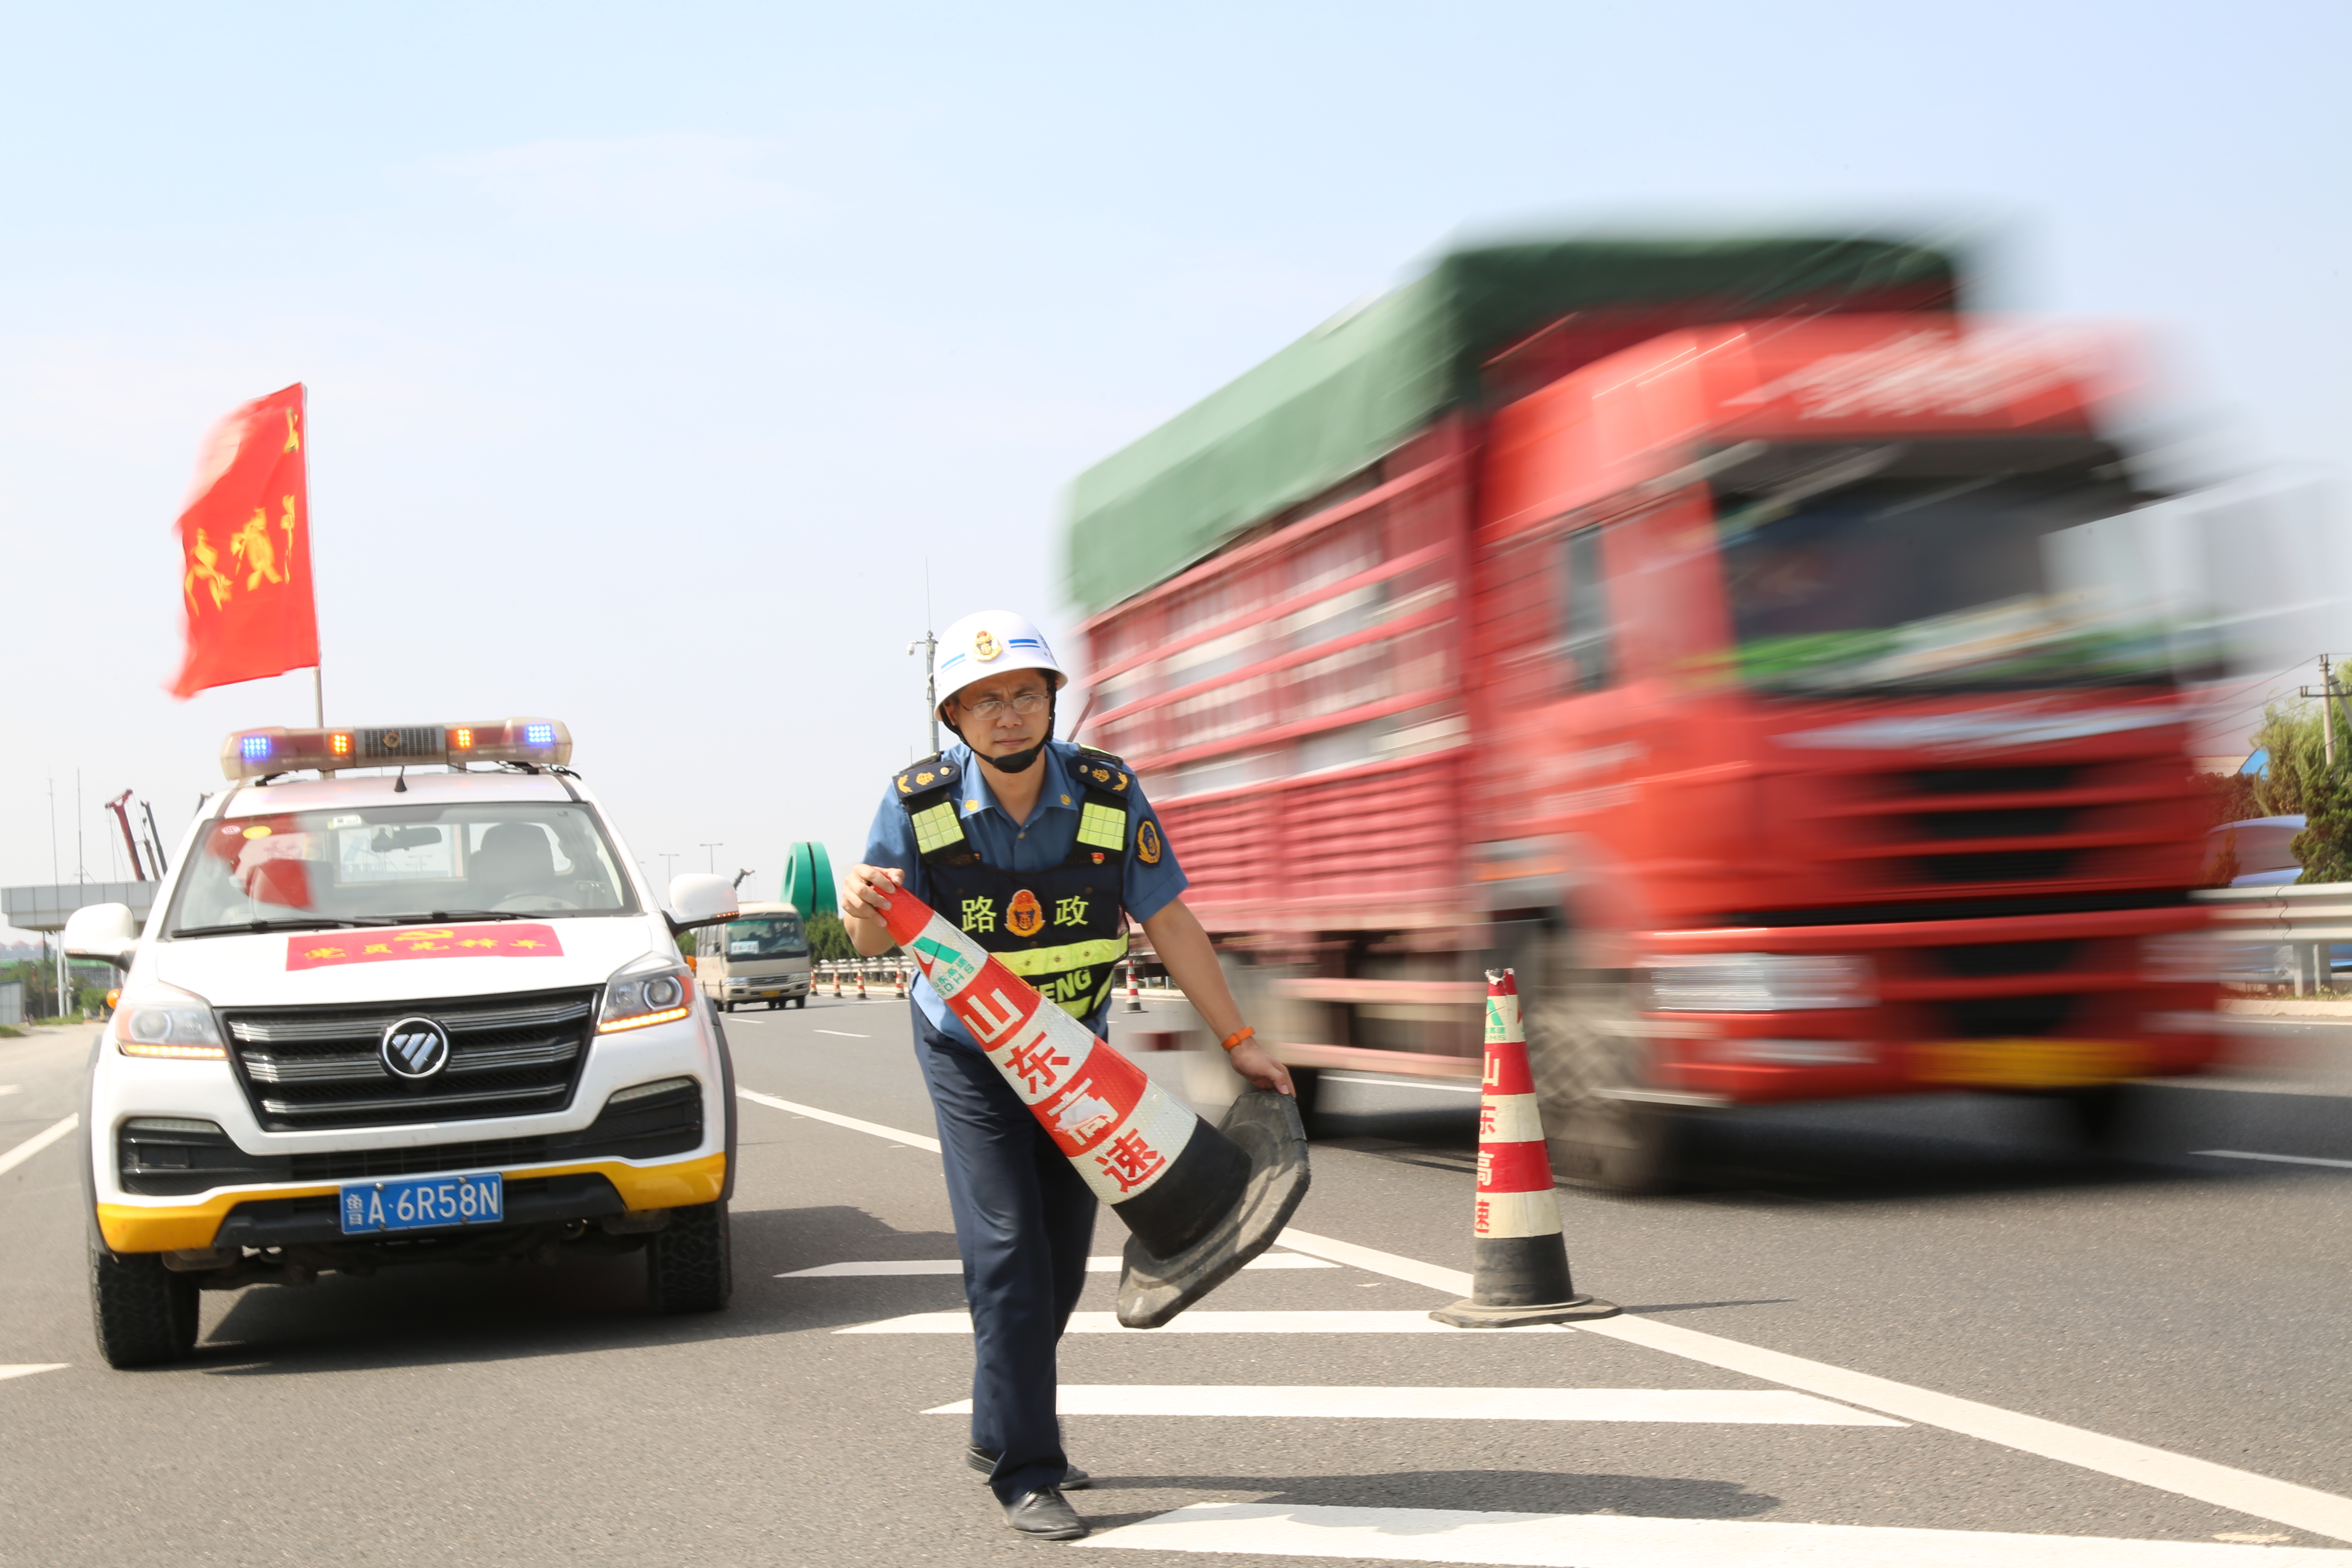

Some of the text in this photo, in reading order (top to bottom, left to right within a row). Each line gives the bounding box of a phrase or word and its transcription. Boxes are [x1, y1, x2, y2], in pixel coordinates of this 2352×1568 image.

[961, 895, 1089, 933] 路 政
[1033, 970, 1092, 1002] ENG
[962, 988, 1166, 1193] 山东高速
[346, 1181, 499, 1226] 鲁A·6R58N
